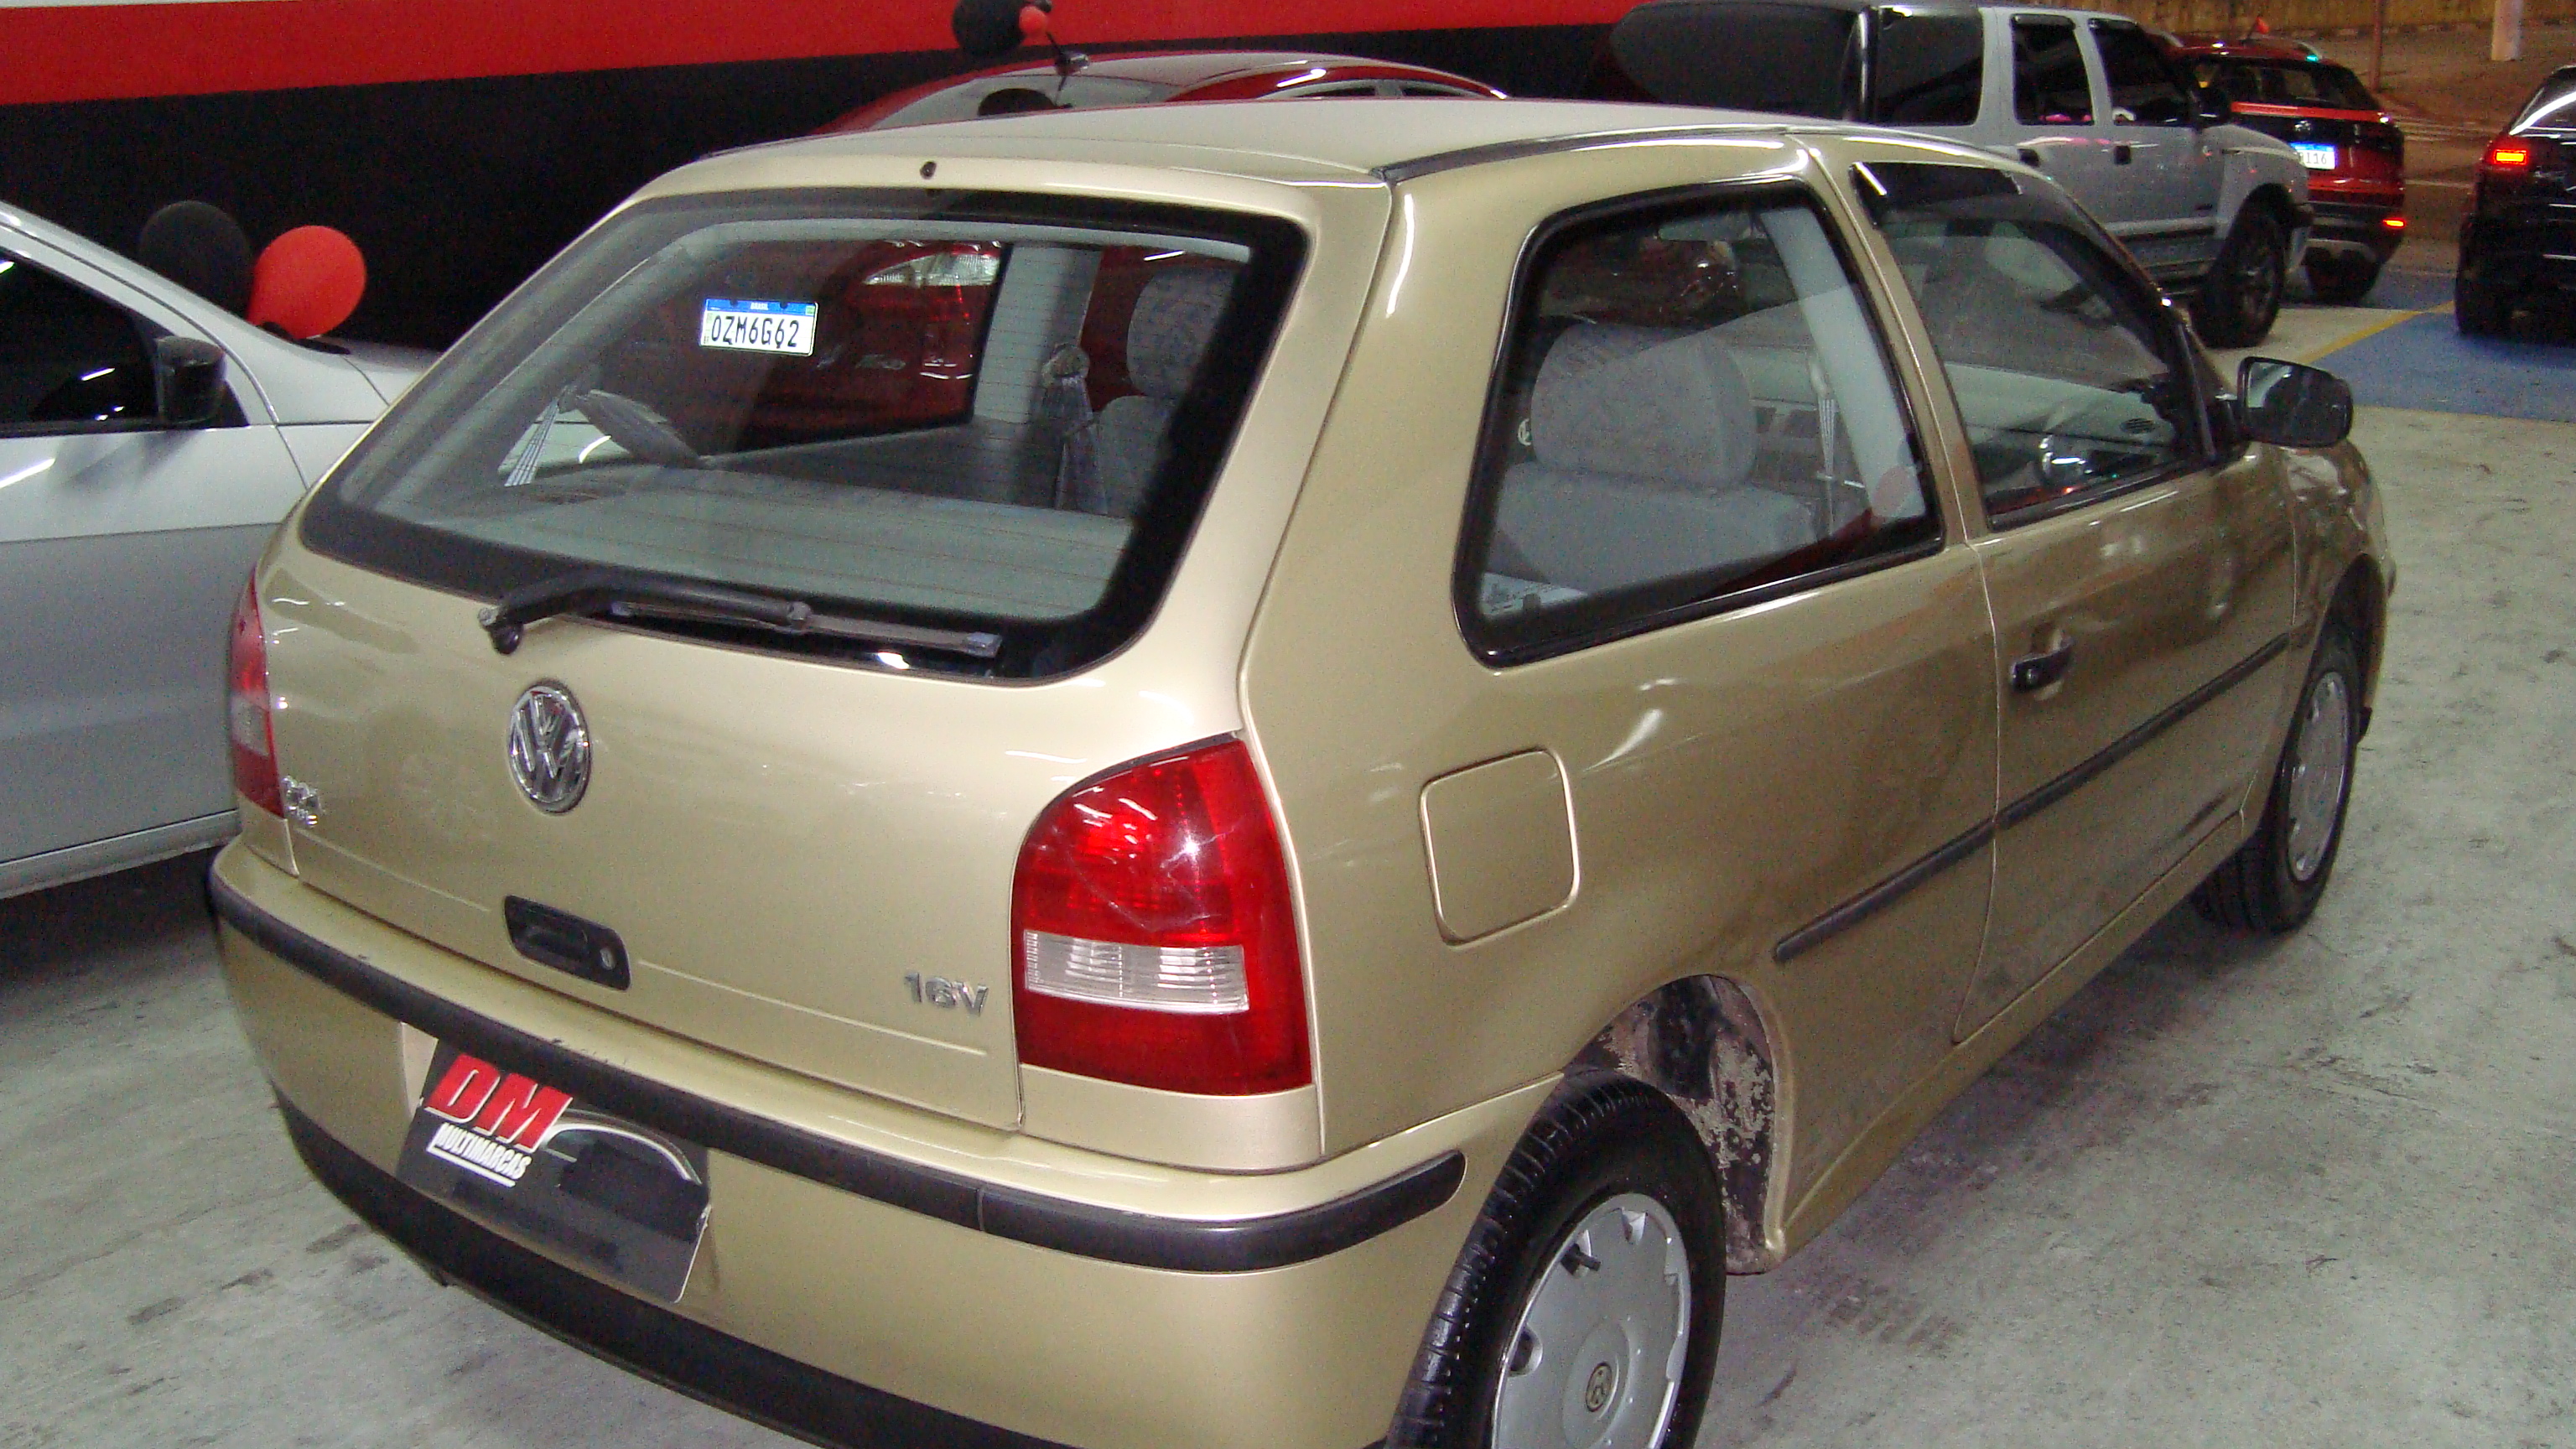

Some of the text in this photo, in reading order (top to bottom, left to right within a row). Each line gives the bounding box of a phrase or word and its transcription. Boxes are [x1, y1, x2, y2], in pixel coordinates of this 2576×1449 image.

[711, 314, 799, 348] OZM6G62
[905, 971, 989, 1017] 16V
[424, 1054, 573, 1153] DM
[428, 1122, 532, 1180] MULTIMARCAS
